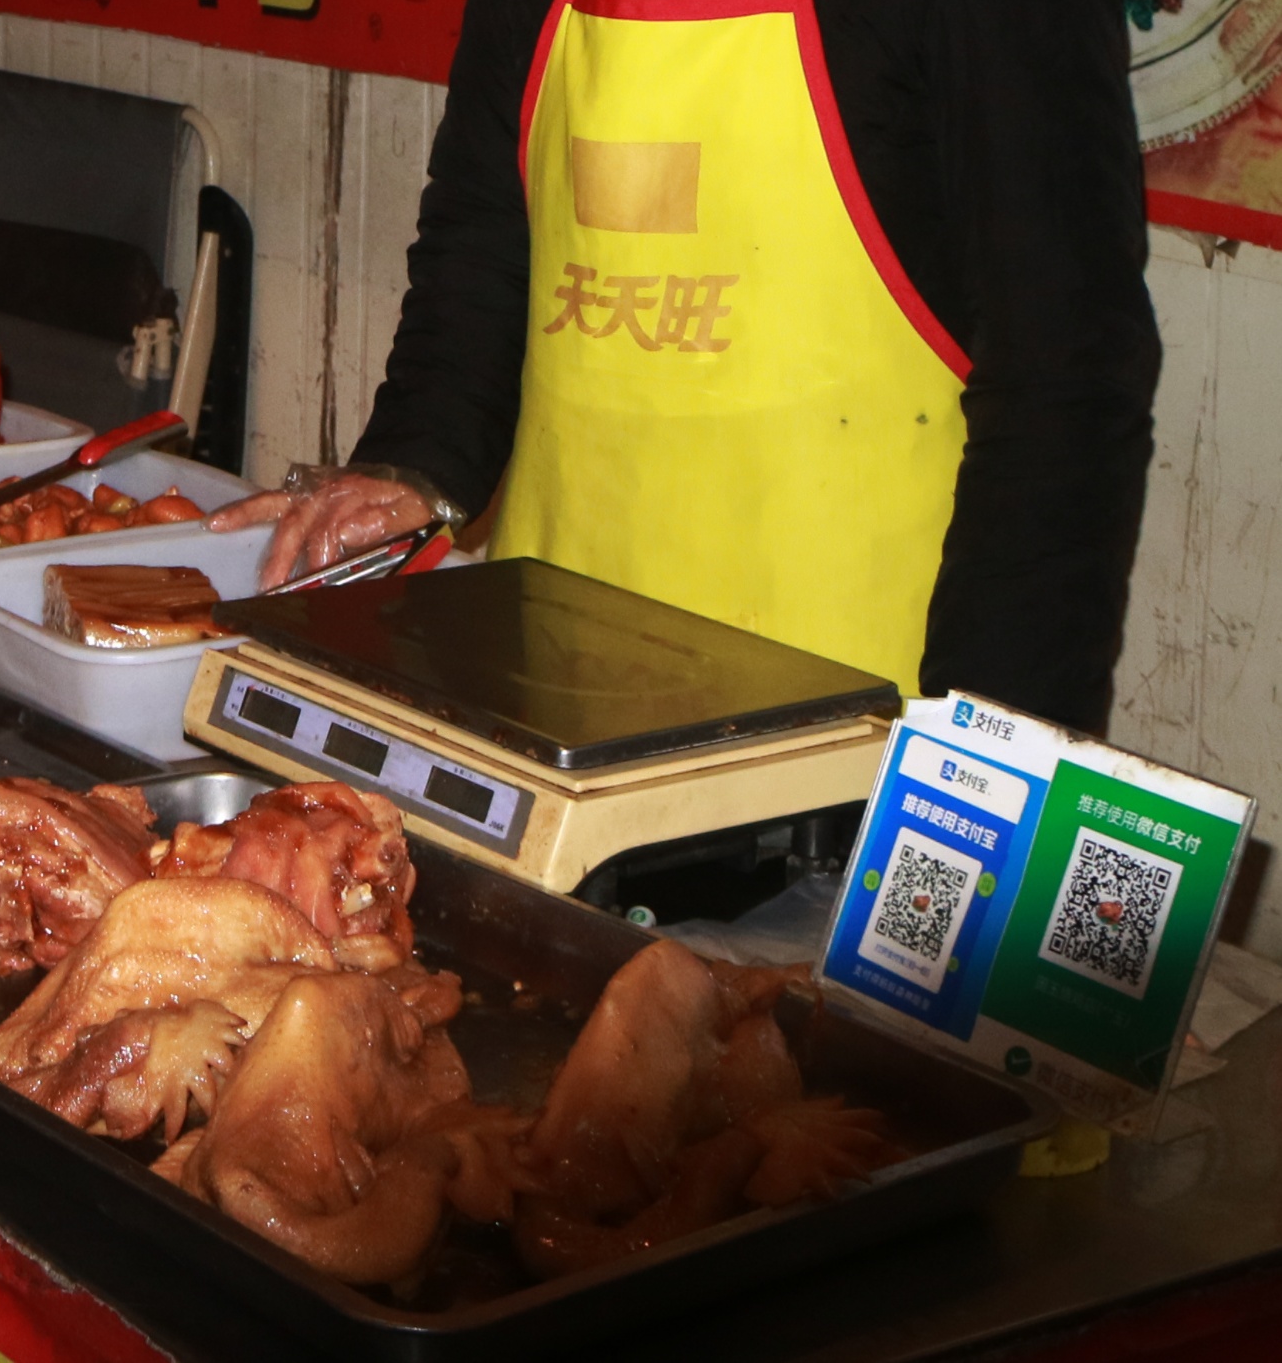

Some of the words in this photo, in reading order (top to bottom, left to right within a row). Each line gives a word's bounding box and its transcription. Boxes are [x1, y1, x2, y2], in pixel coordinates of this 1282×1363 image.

[542, 262, 741, 353] 天天旺
[971, 711, 1016, 742] 支付宝
[955, 769, 990, 795] 支付宝
[901, 792, 999, 852] 推荐使用支付宝
[1076, 792, 1202, 855] 推荐使用微信支付
